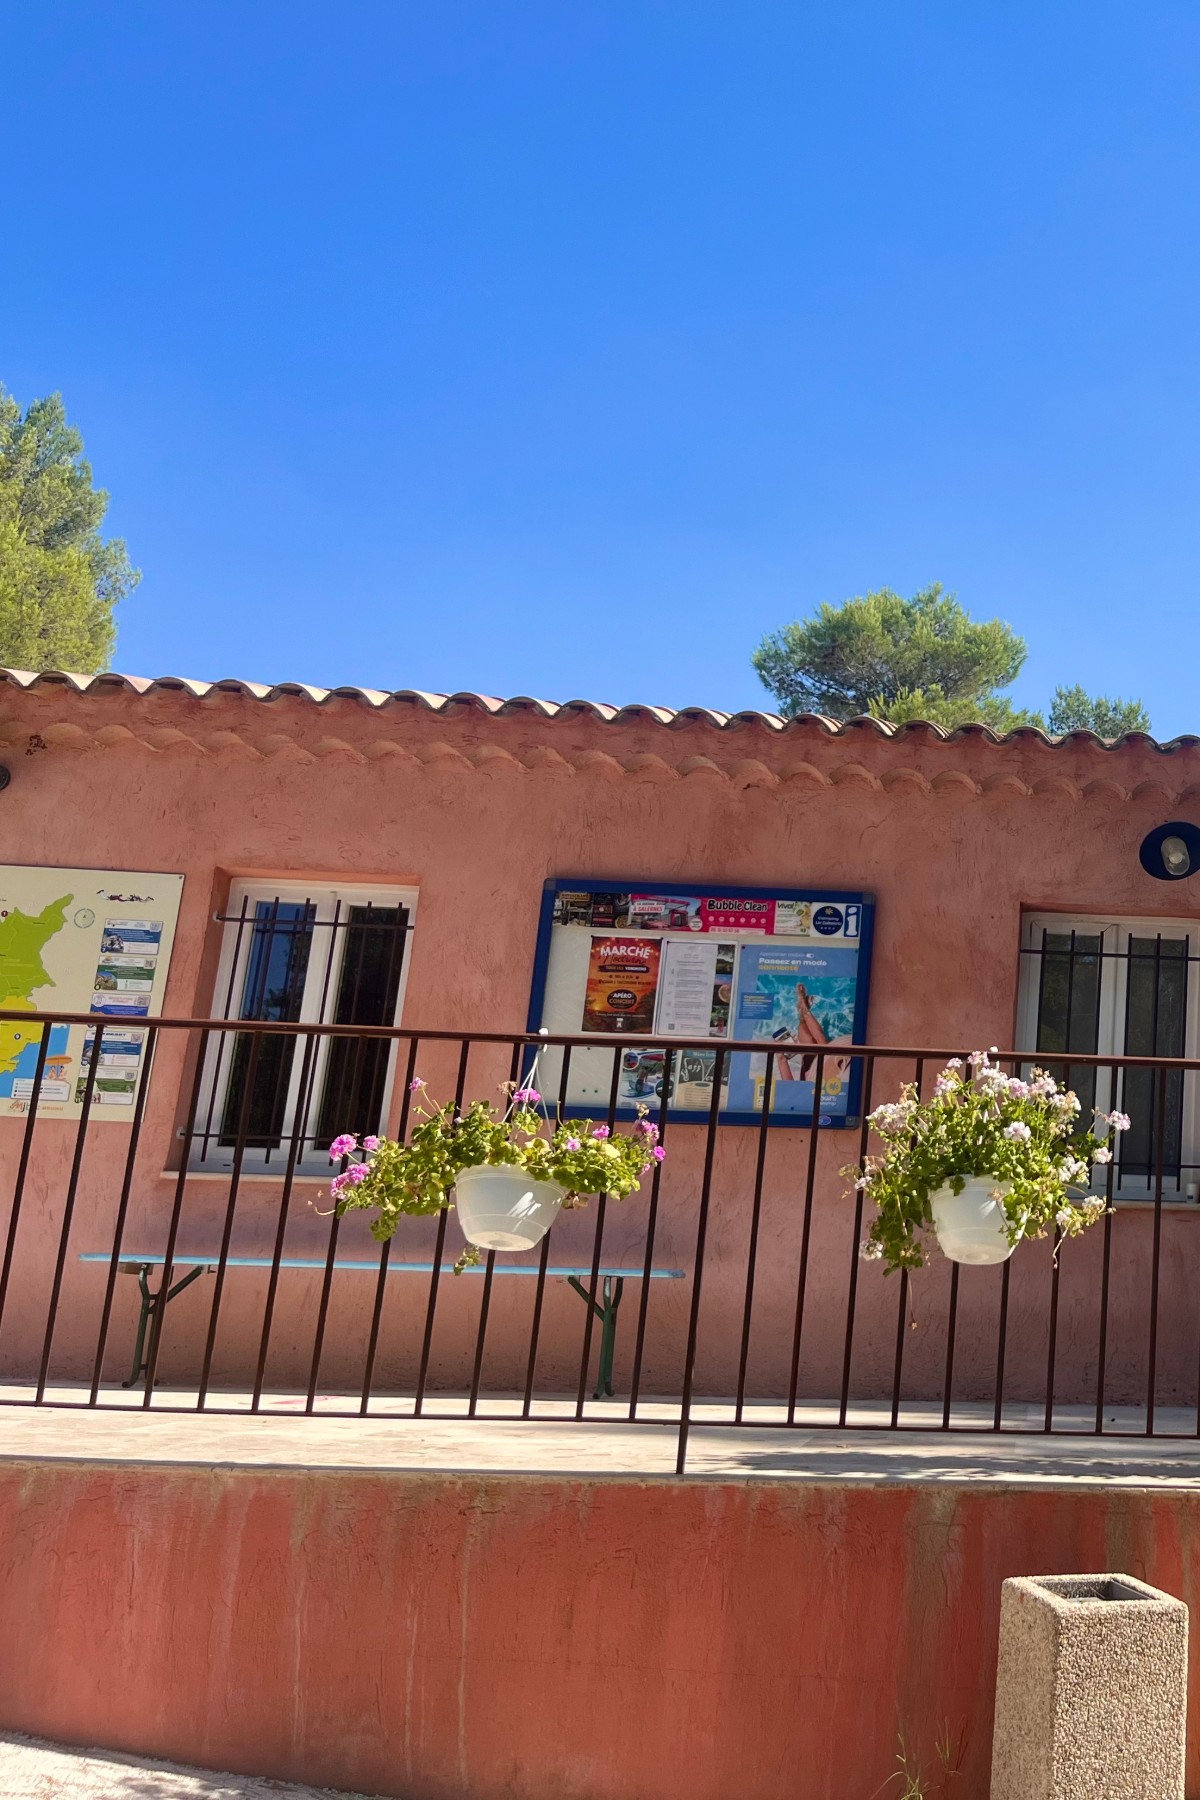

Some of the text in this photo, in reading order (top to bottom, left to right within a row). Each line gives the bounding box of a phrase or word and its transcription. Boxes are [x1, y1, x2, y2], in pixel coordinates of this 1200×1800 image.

[707, 899, 768, 912] Bubble Clean
[600, 945, 652, 959] MARCHÉ
[791, 959, 802, 967] en
[612, 991, 633, 999] APÉRO
